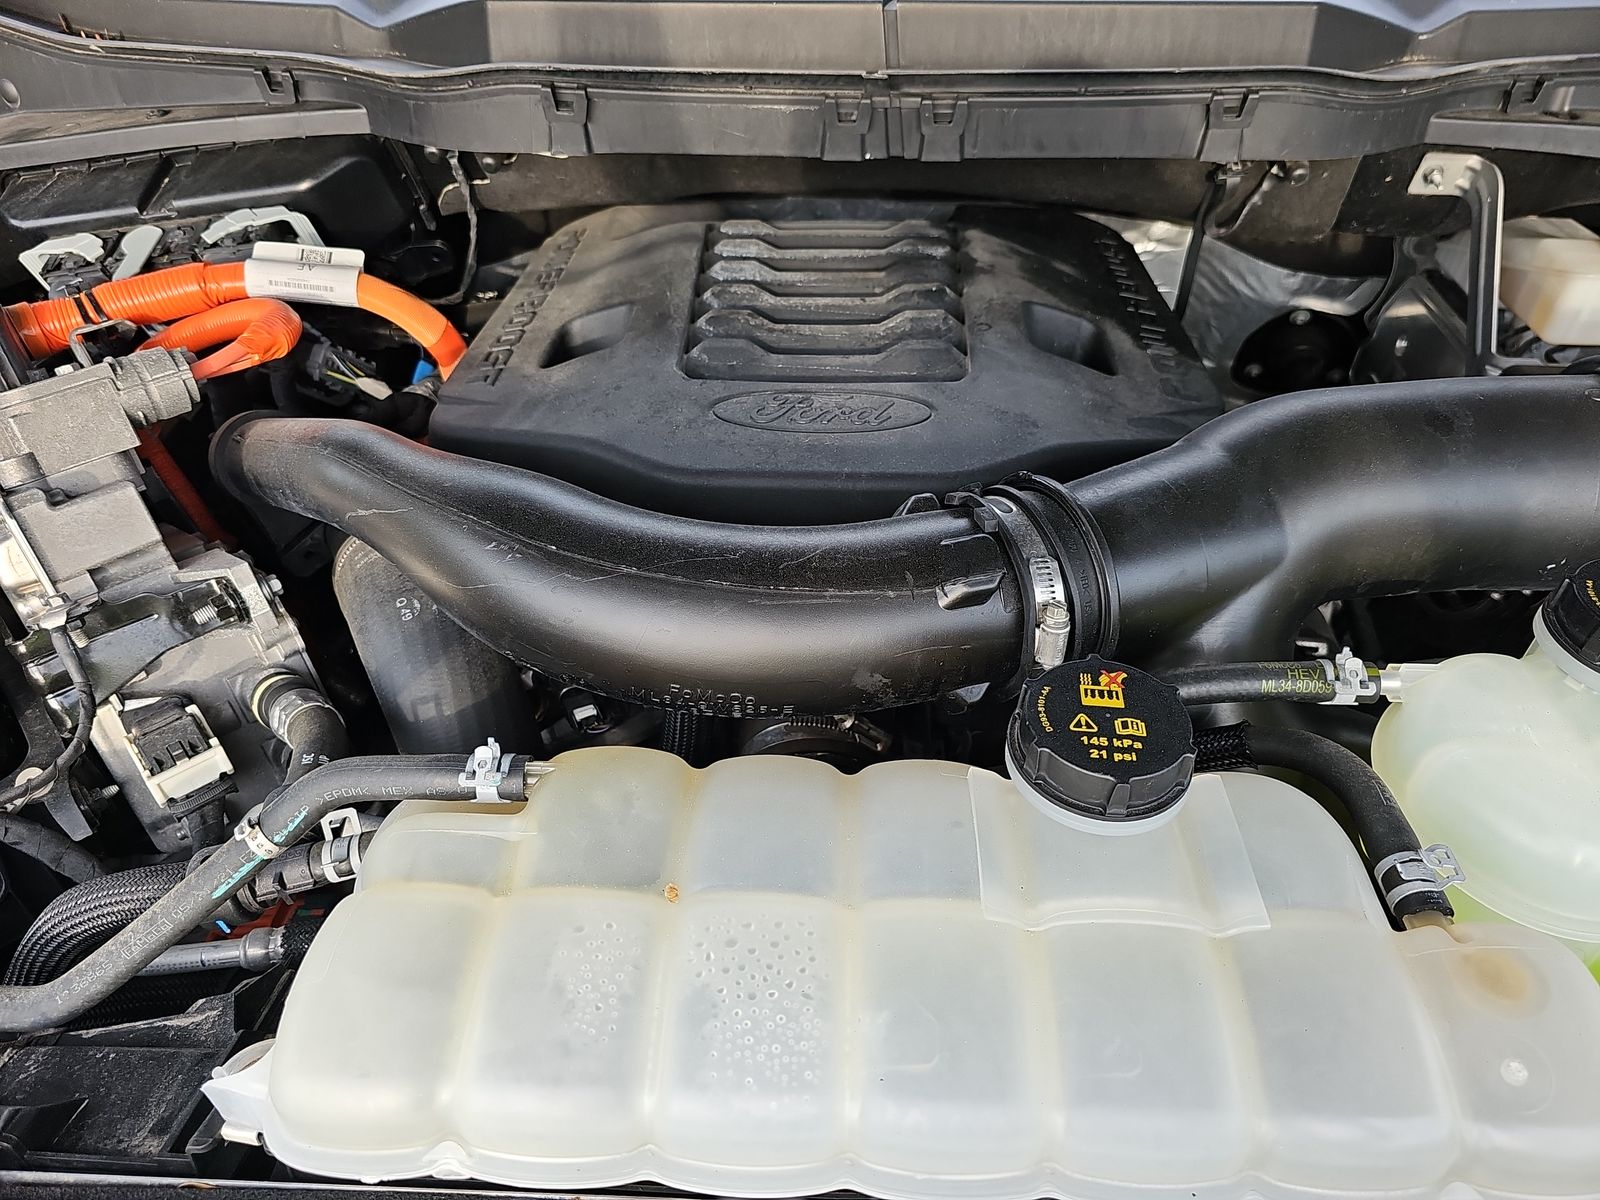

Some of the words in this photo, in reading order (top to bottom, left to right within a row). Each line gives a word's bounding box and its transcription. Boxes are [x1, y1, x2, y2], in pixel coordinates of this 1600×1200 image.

[750, 394, 895, 426] Ford
[1287, 667, 1320, 681] HEV
[669, 683, 756, 706] FoMoCo
[1080, 736, 1109, 748] 145
[1113, 737, 1143, 750] kPa
[1089, 749, 1108, 761] 21
[1114, 750, 1137, 763] psi
[382, 785, 413, 797] MEX
